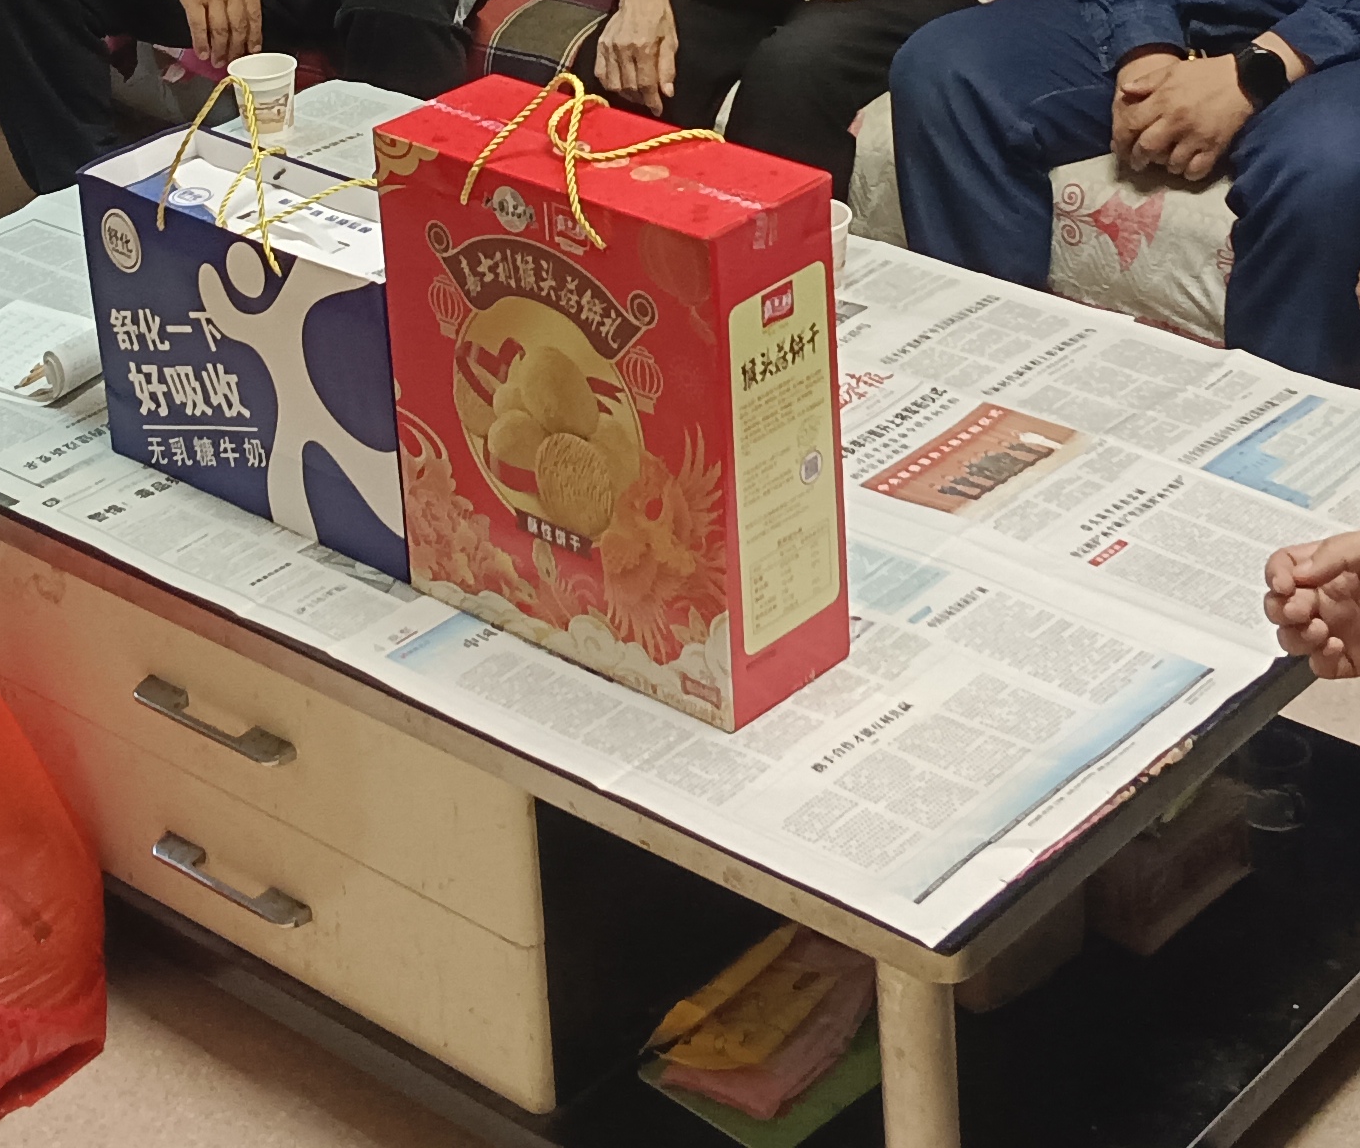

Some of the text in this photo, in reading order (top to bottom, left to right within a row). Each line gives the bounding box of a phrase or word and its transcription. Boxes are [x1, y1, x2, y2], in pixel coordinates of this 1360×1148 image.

[107, 226, 133, 253] 舒化
[110, 308, 222, 352] 舒化一下
[128, 361, 251, 419] 好吸收
[147, 435, 268, 468] 无乳糖牛奶
